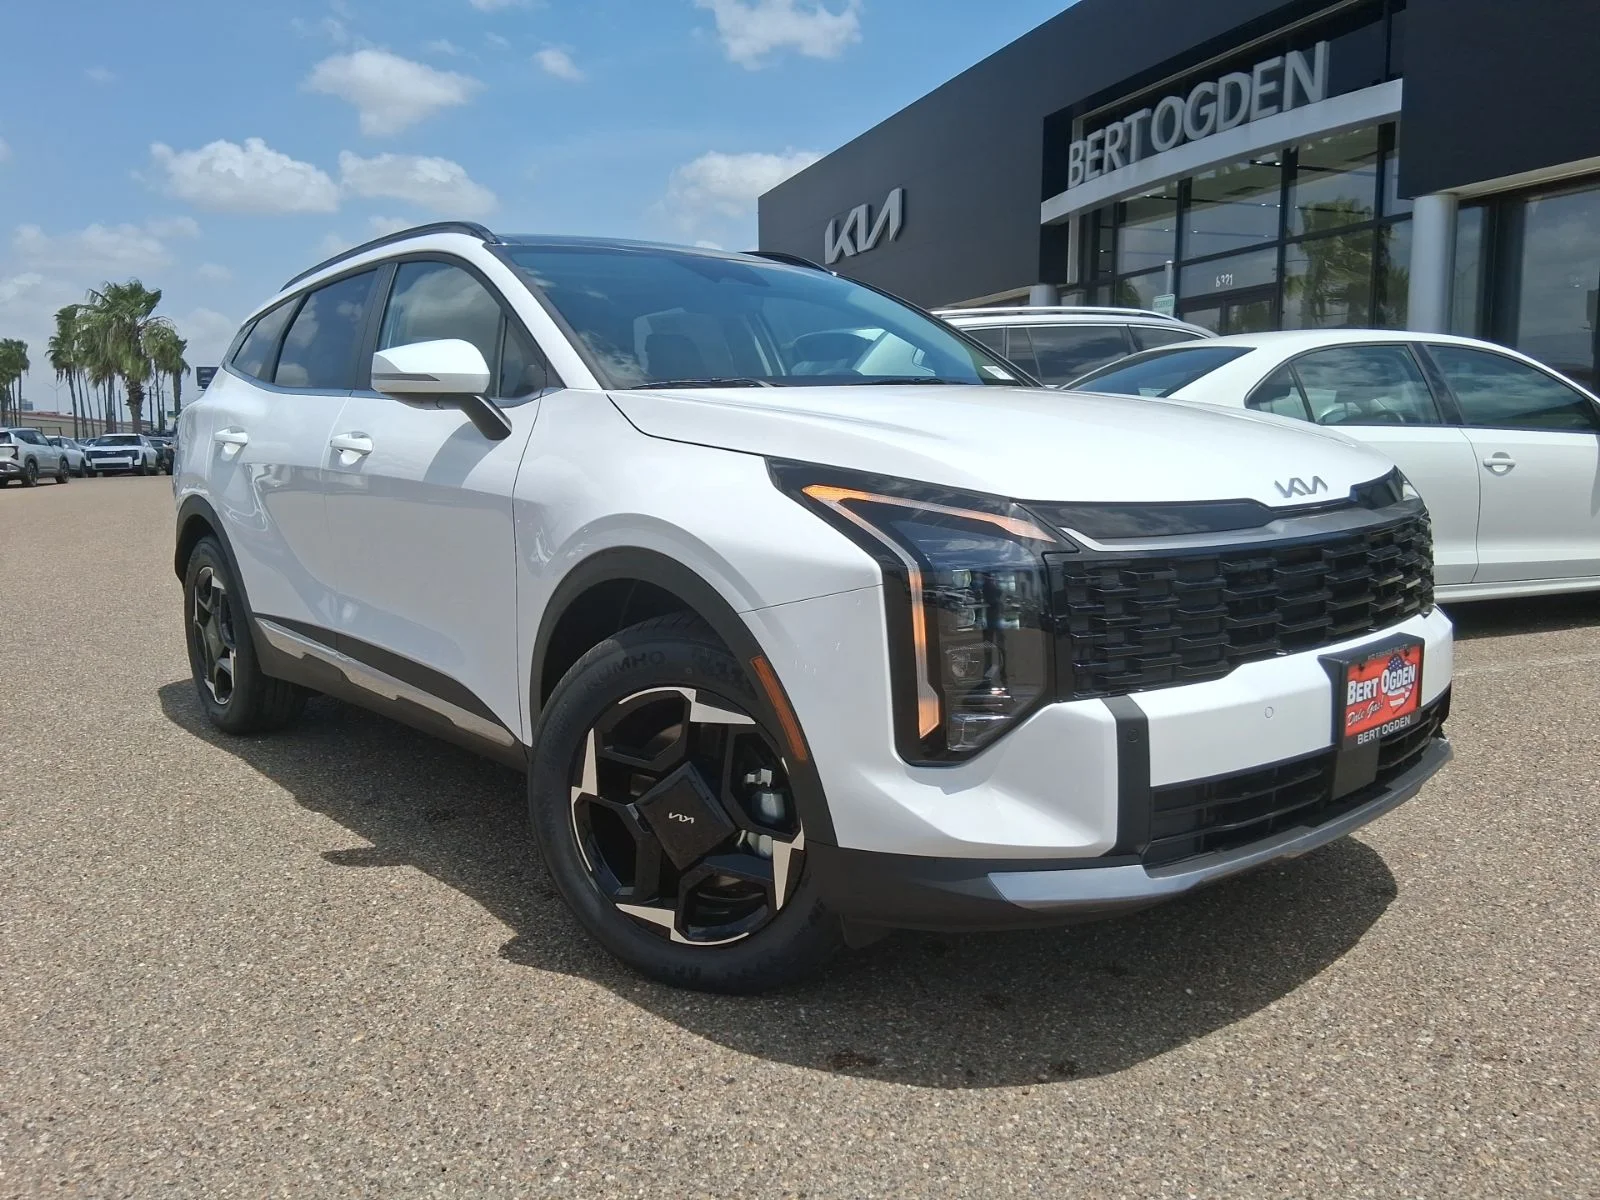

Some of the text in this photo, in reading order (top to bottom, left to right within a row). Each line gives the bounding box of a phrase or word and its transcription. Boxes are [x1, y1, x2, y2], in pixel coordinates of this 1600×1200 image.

[1068, 41, 1330, 189] BERT OGDEN
[824, 187, 903, 265] KIA
[1274, 475, 1328, 498] KIA
[1346, 664, 1416, 706] BERT OGDEN
[1357, 715, 1411, 745] BERT OGDEN
